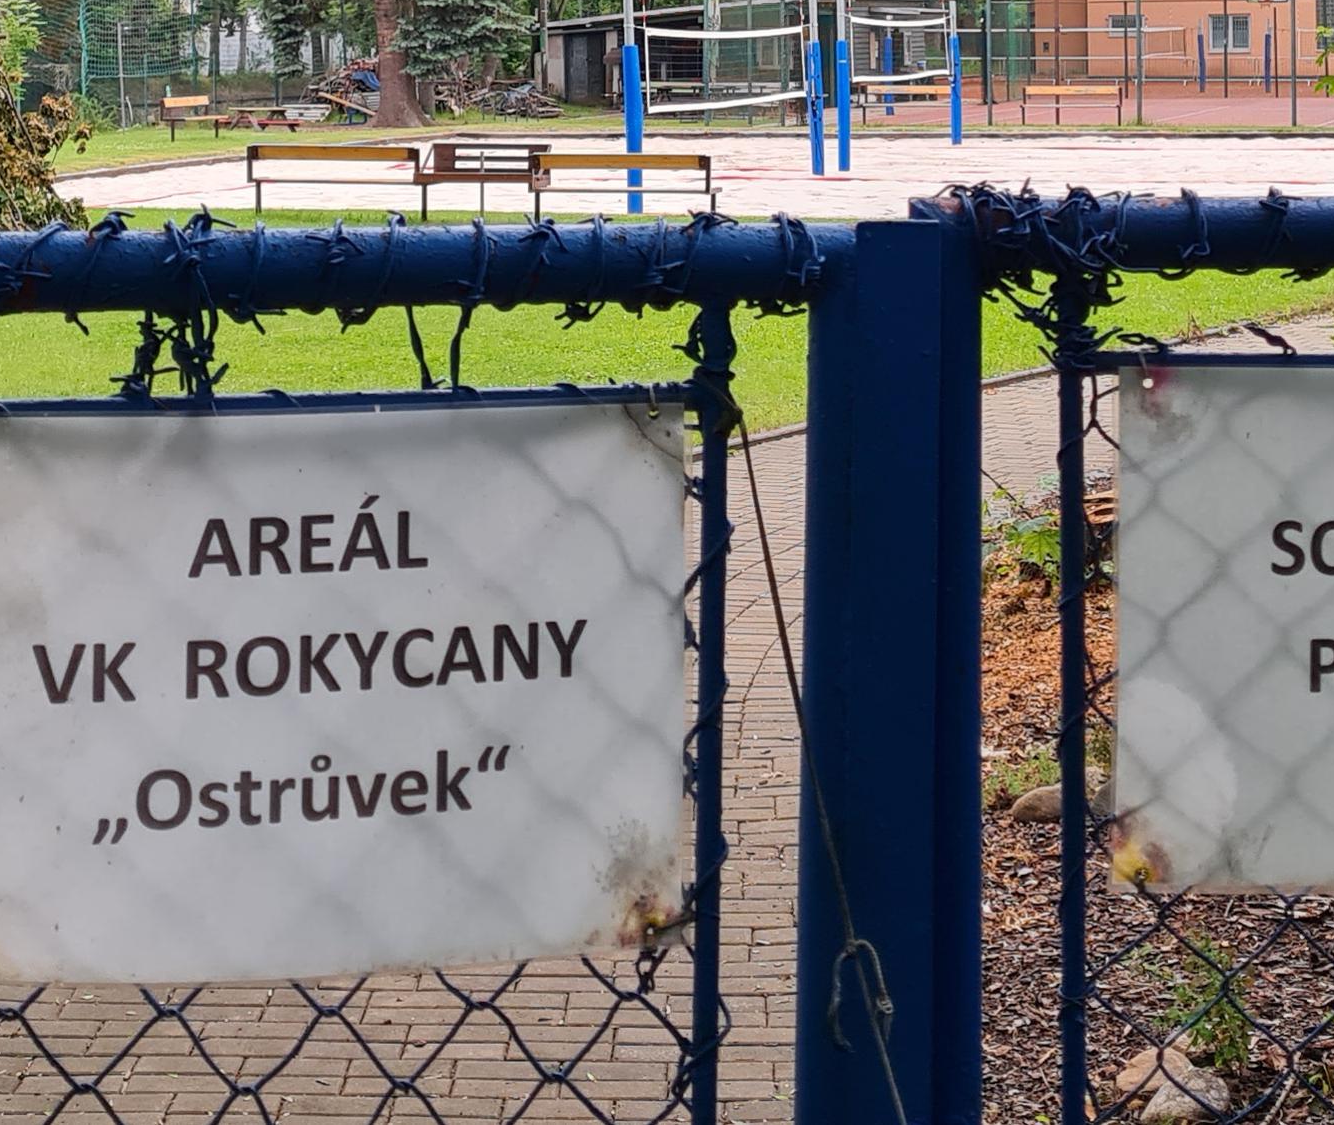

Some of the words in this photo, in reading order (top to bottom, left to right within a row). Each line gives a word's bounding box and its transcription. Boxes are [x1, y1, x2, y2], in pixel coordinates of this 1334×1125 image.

[187, 493, 430, 579] AREÁL
[32, 642, 137, 704] VK
[185, 619, 589, 700] ROKYCANY
[92, 744, 513, 846] „Ostrůvek“
